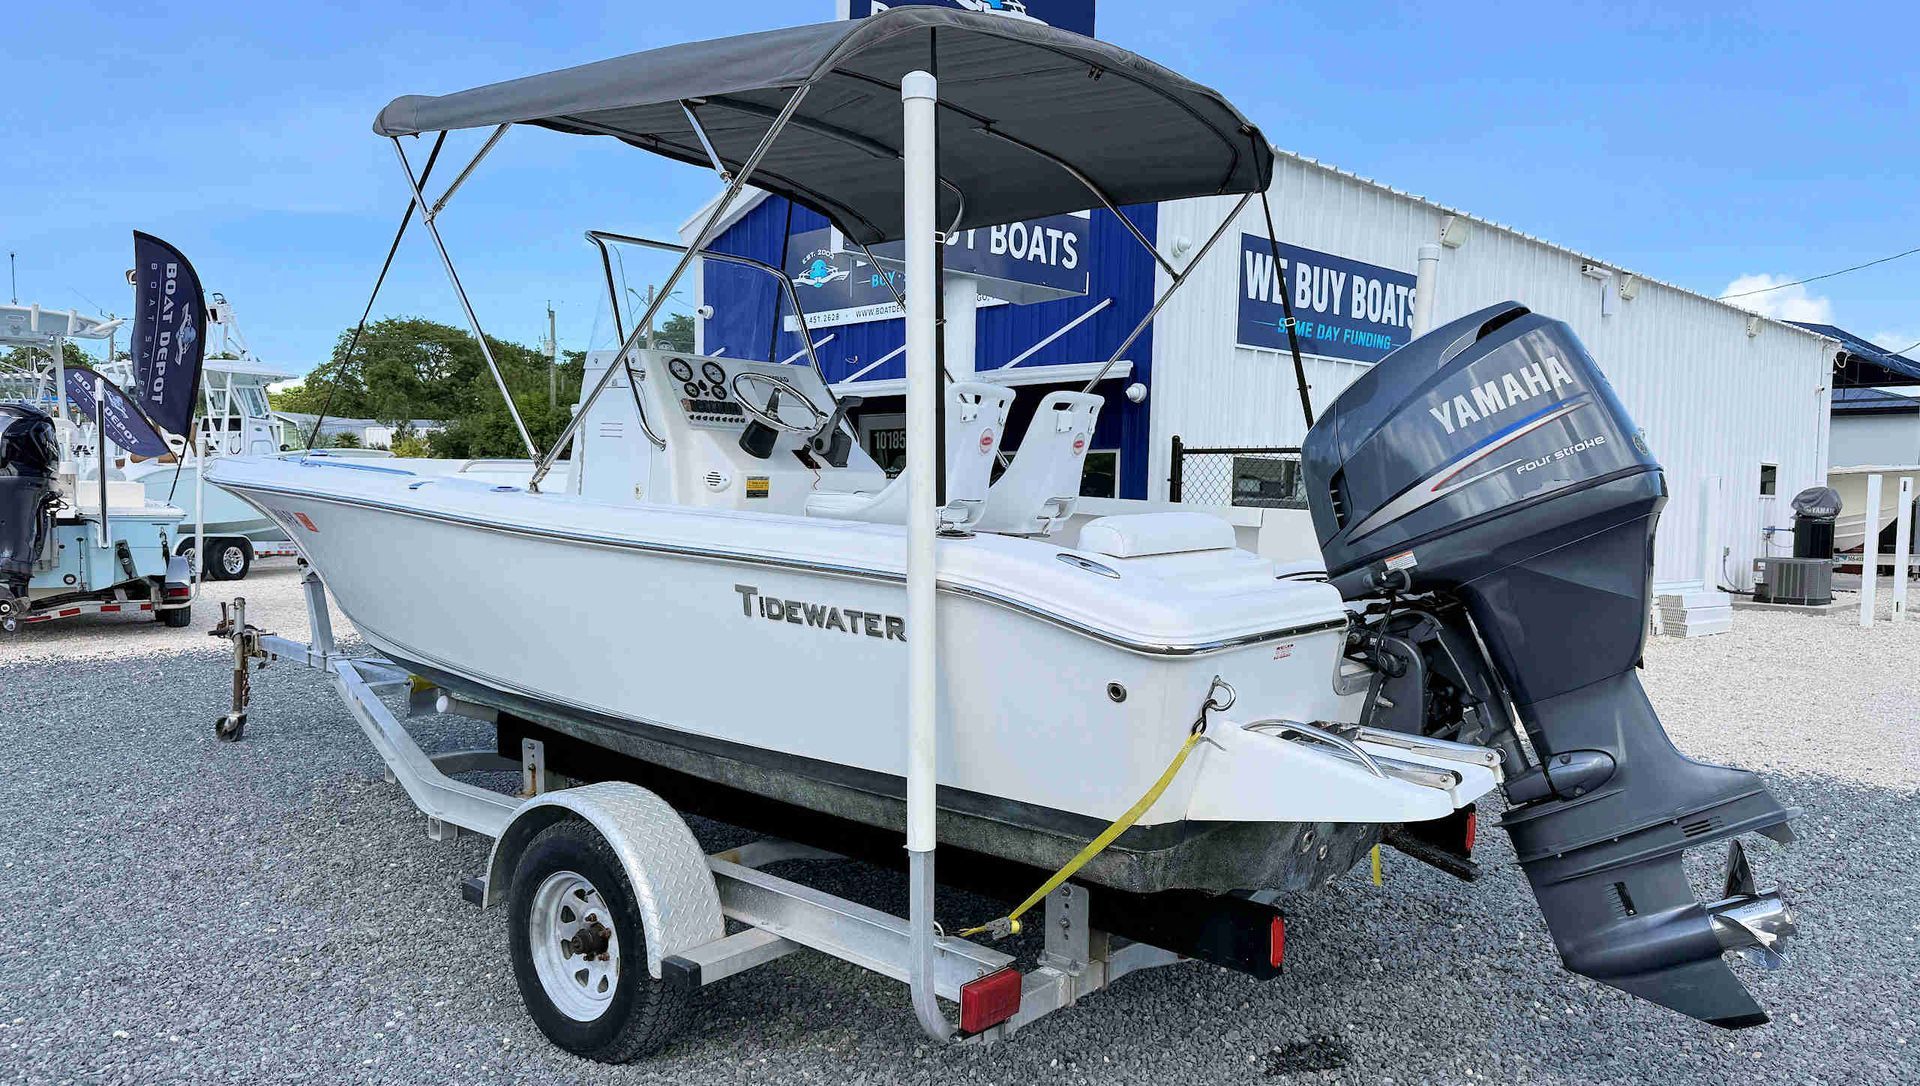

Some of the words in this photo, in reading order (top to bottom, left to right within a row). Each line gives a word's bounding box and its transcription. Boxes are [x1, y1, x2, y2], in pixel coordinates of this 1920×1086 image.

[990, 221, 1078, 270] BOATS
[147, 262, 158, 322] BOAT
[162, 262, 178, 324] BOAT
[1295, 262, 1347, 316] BUY
[1351, 274, 1417, 330] BOATS
[1277, 317, 1314, 339] SME
[1316, 323, 1341, 342] DAY
[1343, 329, 1392, 350] FUNDING
[151, 331, 172, 405] DEPOT
[1429, 356, 1574, 435] YAMAHA
[104, 406, 140, 445] DEPOT
